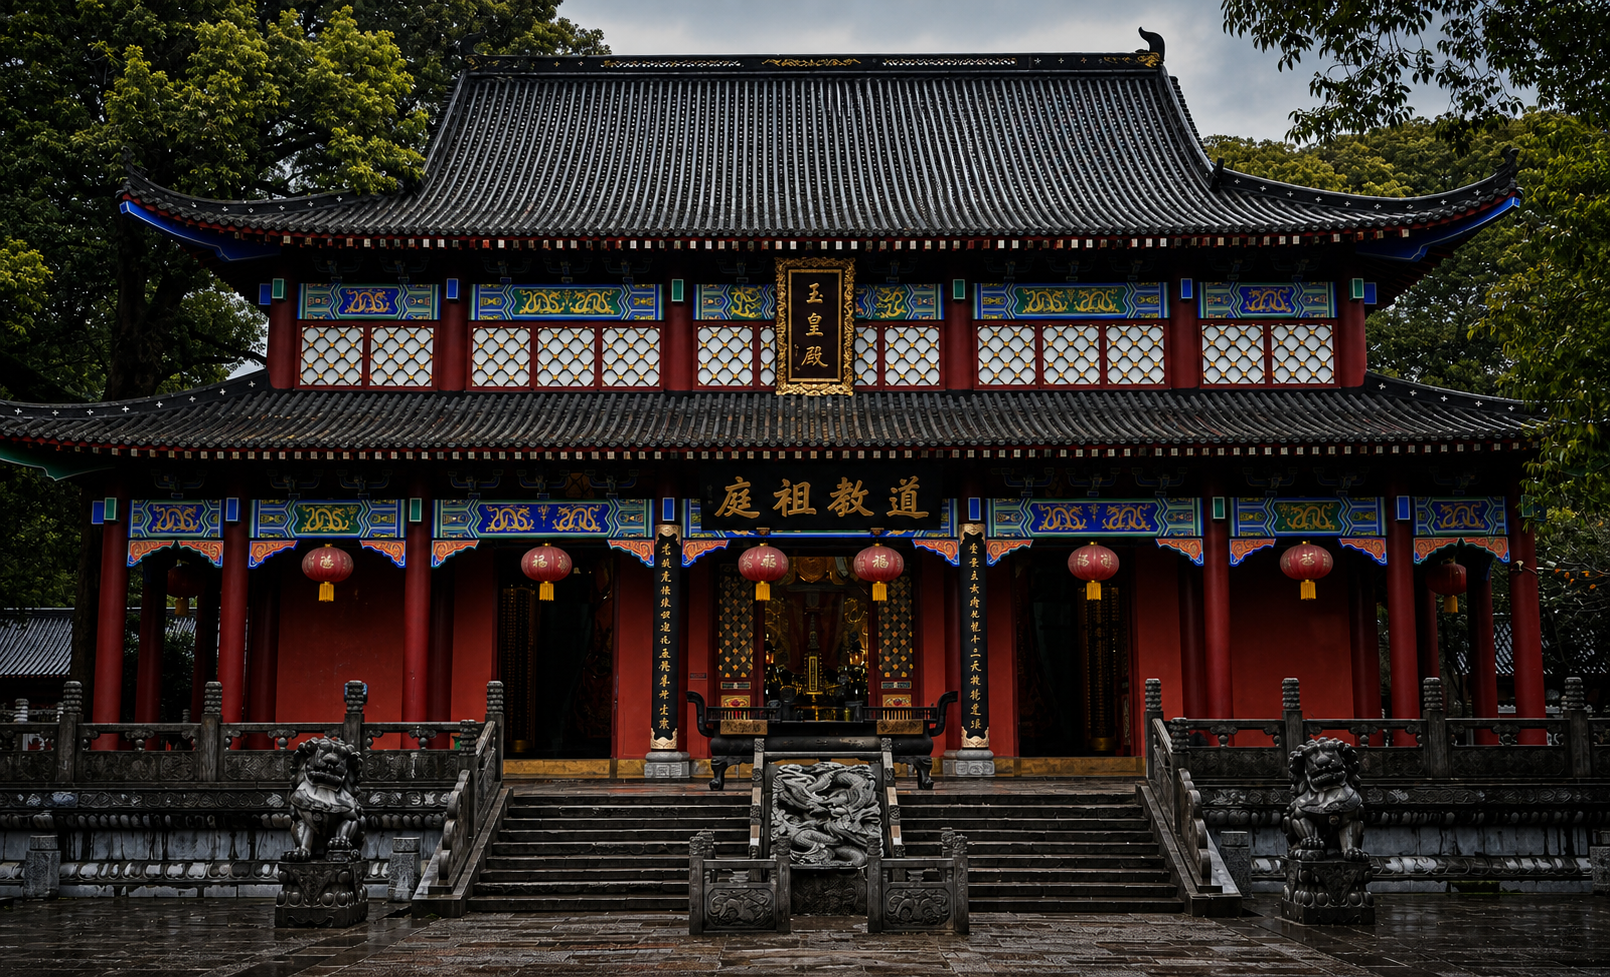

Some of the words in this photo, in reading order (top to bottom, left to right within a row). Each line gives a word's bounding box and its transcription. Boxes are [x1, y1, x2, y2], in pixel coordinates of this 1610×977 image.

[801, 282, 829, 368] 玉皇殿
[532, 554, 548, 568] 福
[872, 554, 890, 569] 福
